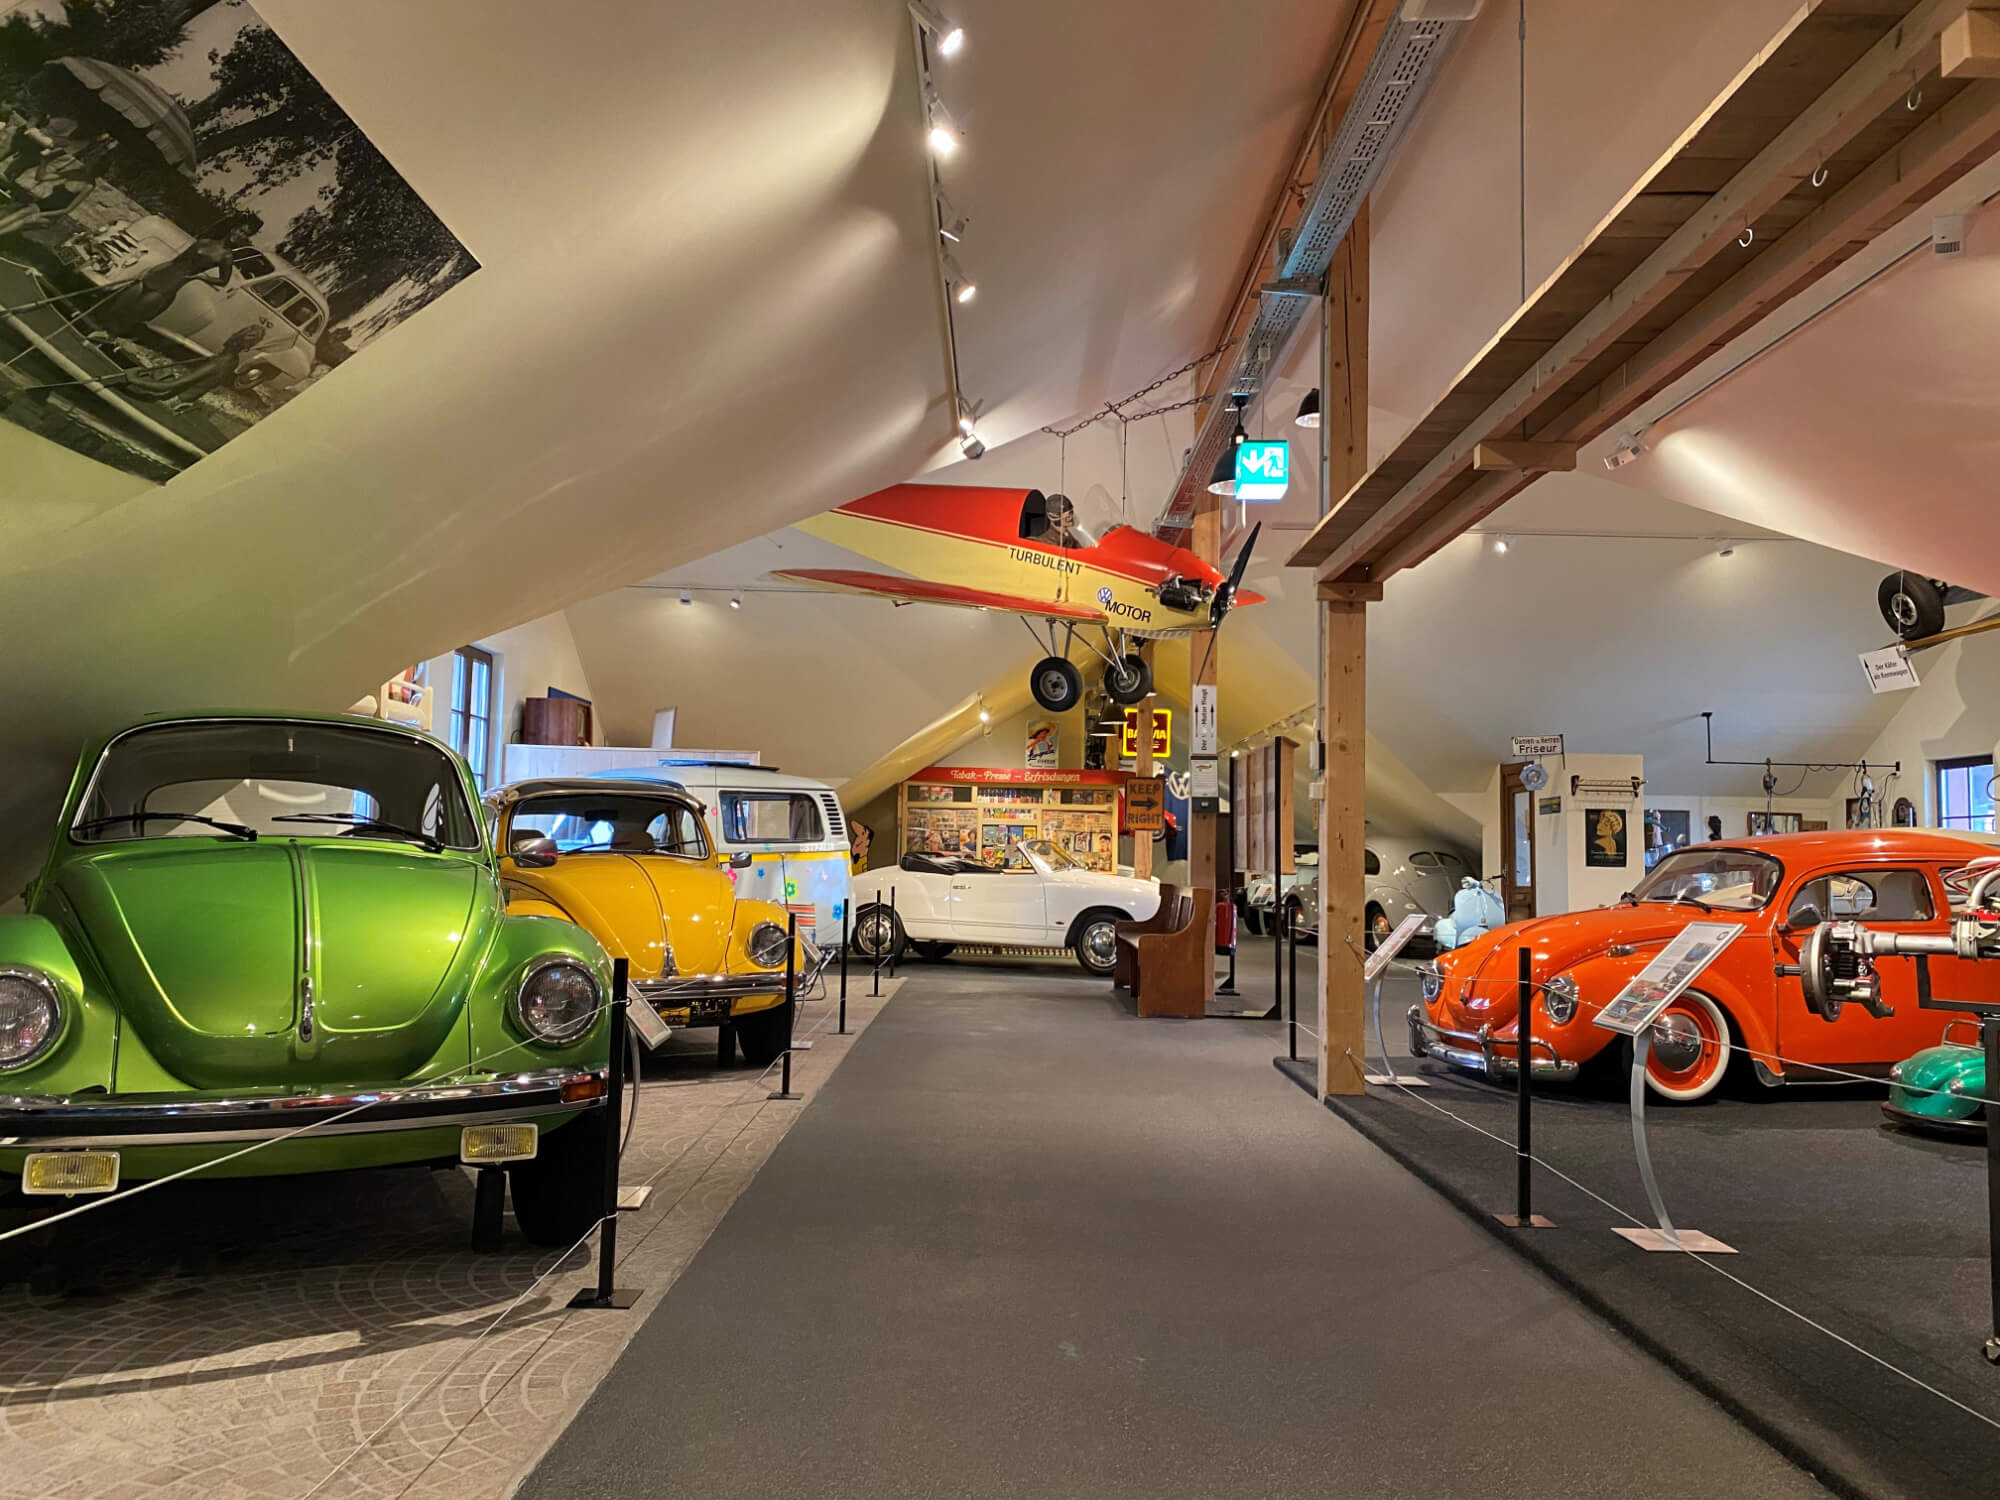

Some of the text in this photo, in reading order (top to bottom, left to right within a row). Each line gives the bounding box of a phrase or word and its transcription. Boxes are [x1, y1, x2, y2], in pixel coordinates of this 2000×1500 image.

[1009, 547, 1083, 575] TURBULENT
[1097, 587, 1113, 603] VW
[1104, 600, 1151, 623] MOTOR
[1519, 744, 1558, 754] Friseur
[1129, 783, 1160, 794] KEEP
[1128, 813, 1161, 825] RIGHT
